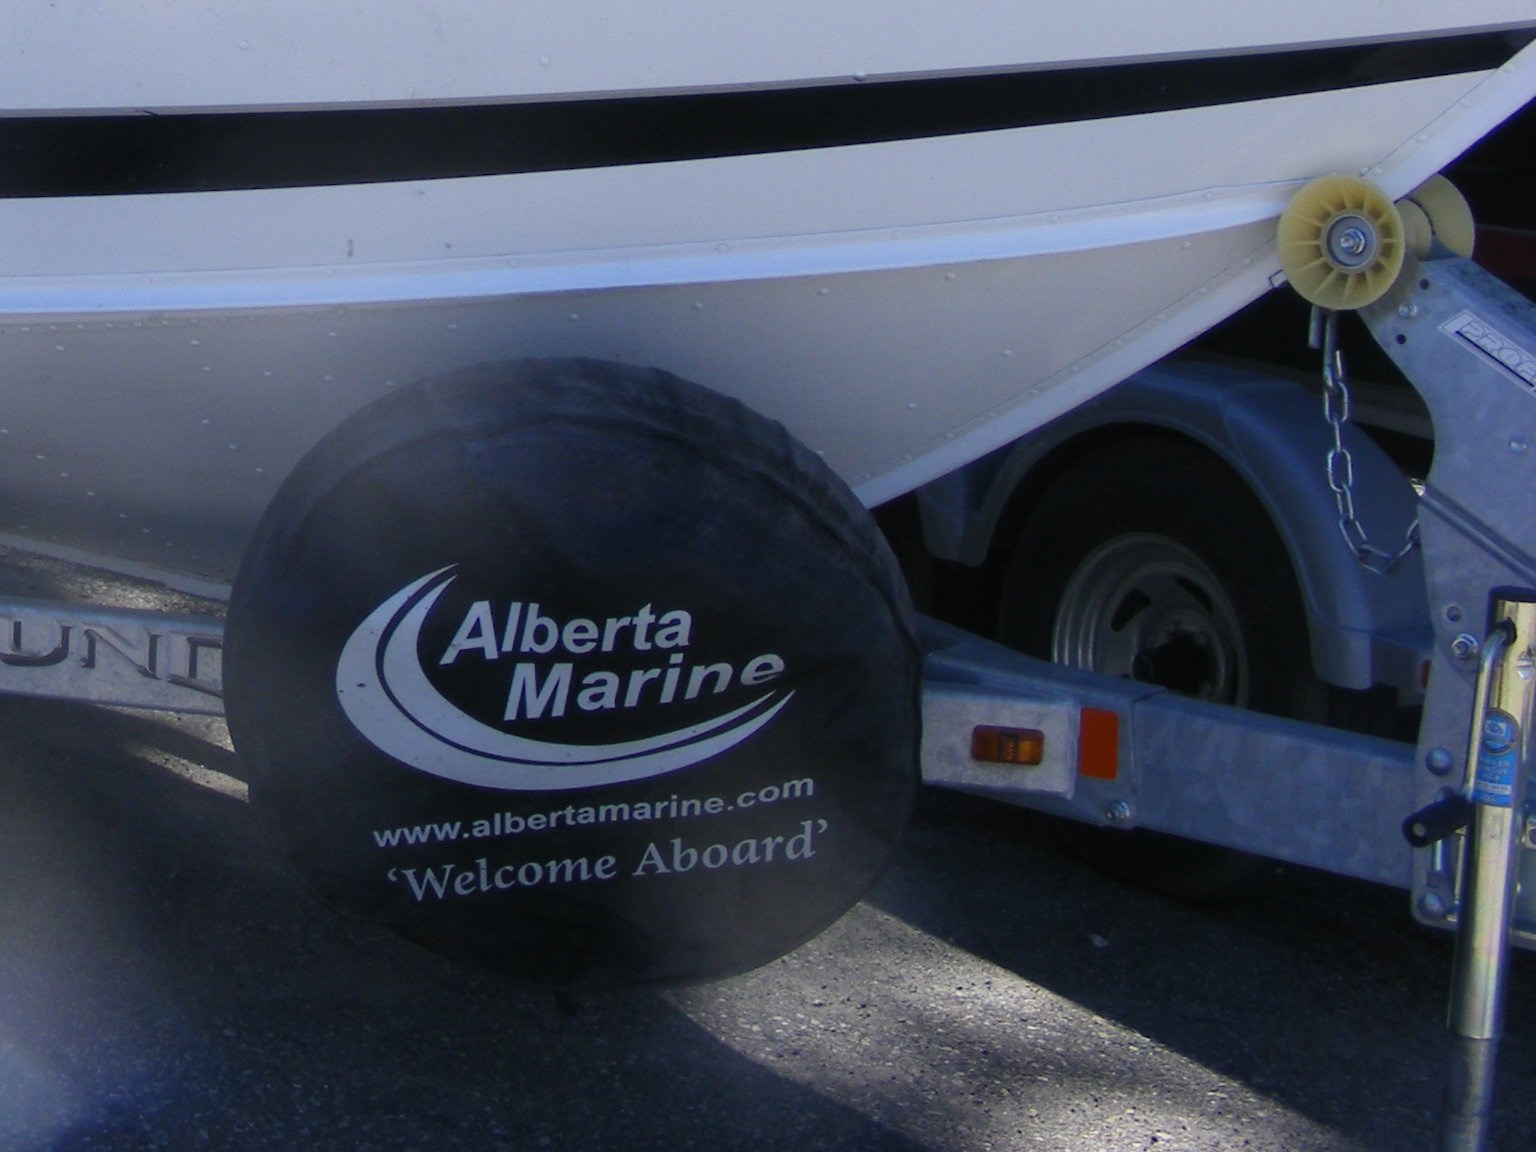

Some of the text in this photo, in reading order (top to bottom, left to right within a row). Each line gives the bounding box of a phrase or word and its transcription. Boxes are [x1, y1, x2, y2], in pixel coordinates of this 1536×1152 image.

[438, 599, 693, 666] Alberta
[503, 652, 786, 722] Marine
[373, 776, 816, 848] www.albertamarine.com
